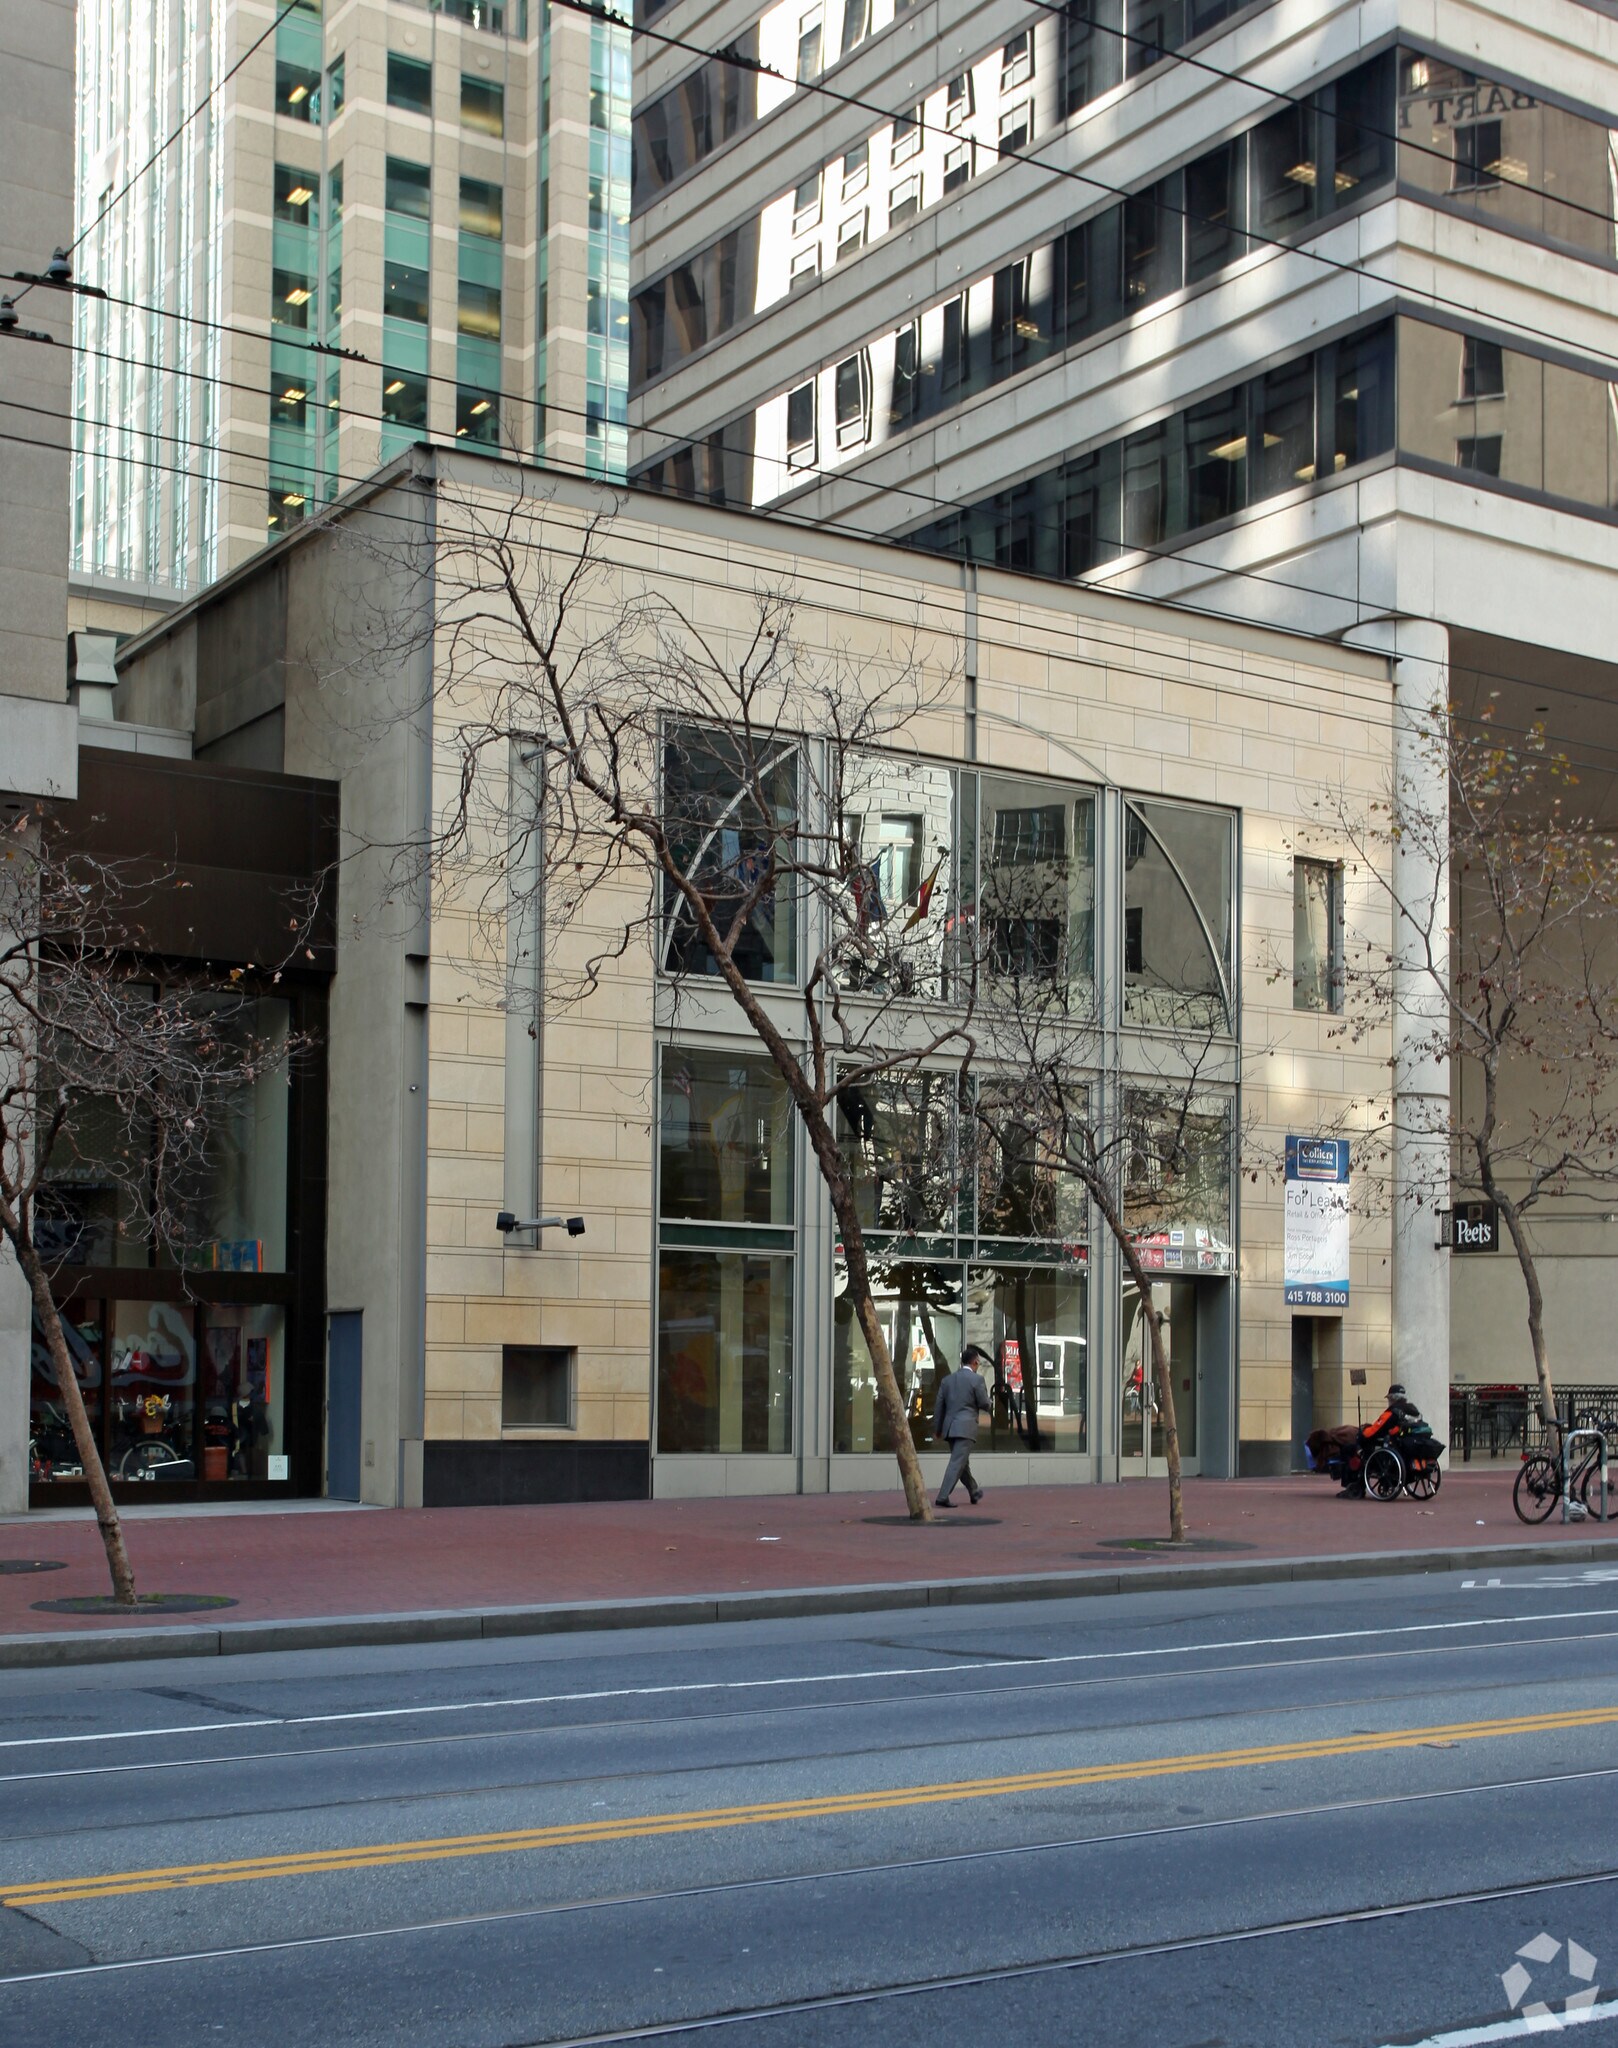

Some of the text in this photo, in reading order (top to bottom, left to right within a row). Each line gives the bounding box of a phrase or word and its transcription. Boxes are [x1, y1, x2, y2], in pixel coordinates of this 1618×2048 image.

[1302, 1145, 1334, 1160] Colliers
[1287, 1190, 1344, 1208] For Lea
[1456, 1219, 1492, 1244] Peet's
[1287, 1290, 1347, 1304] 415 788 3100
